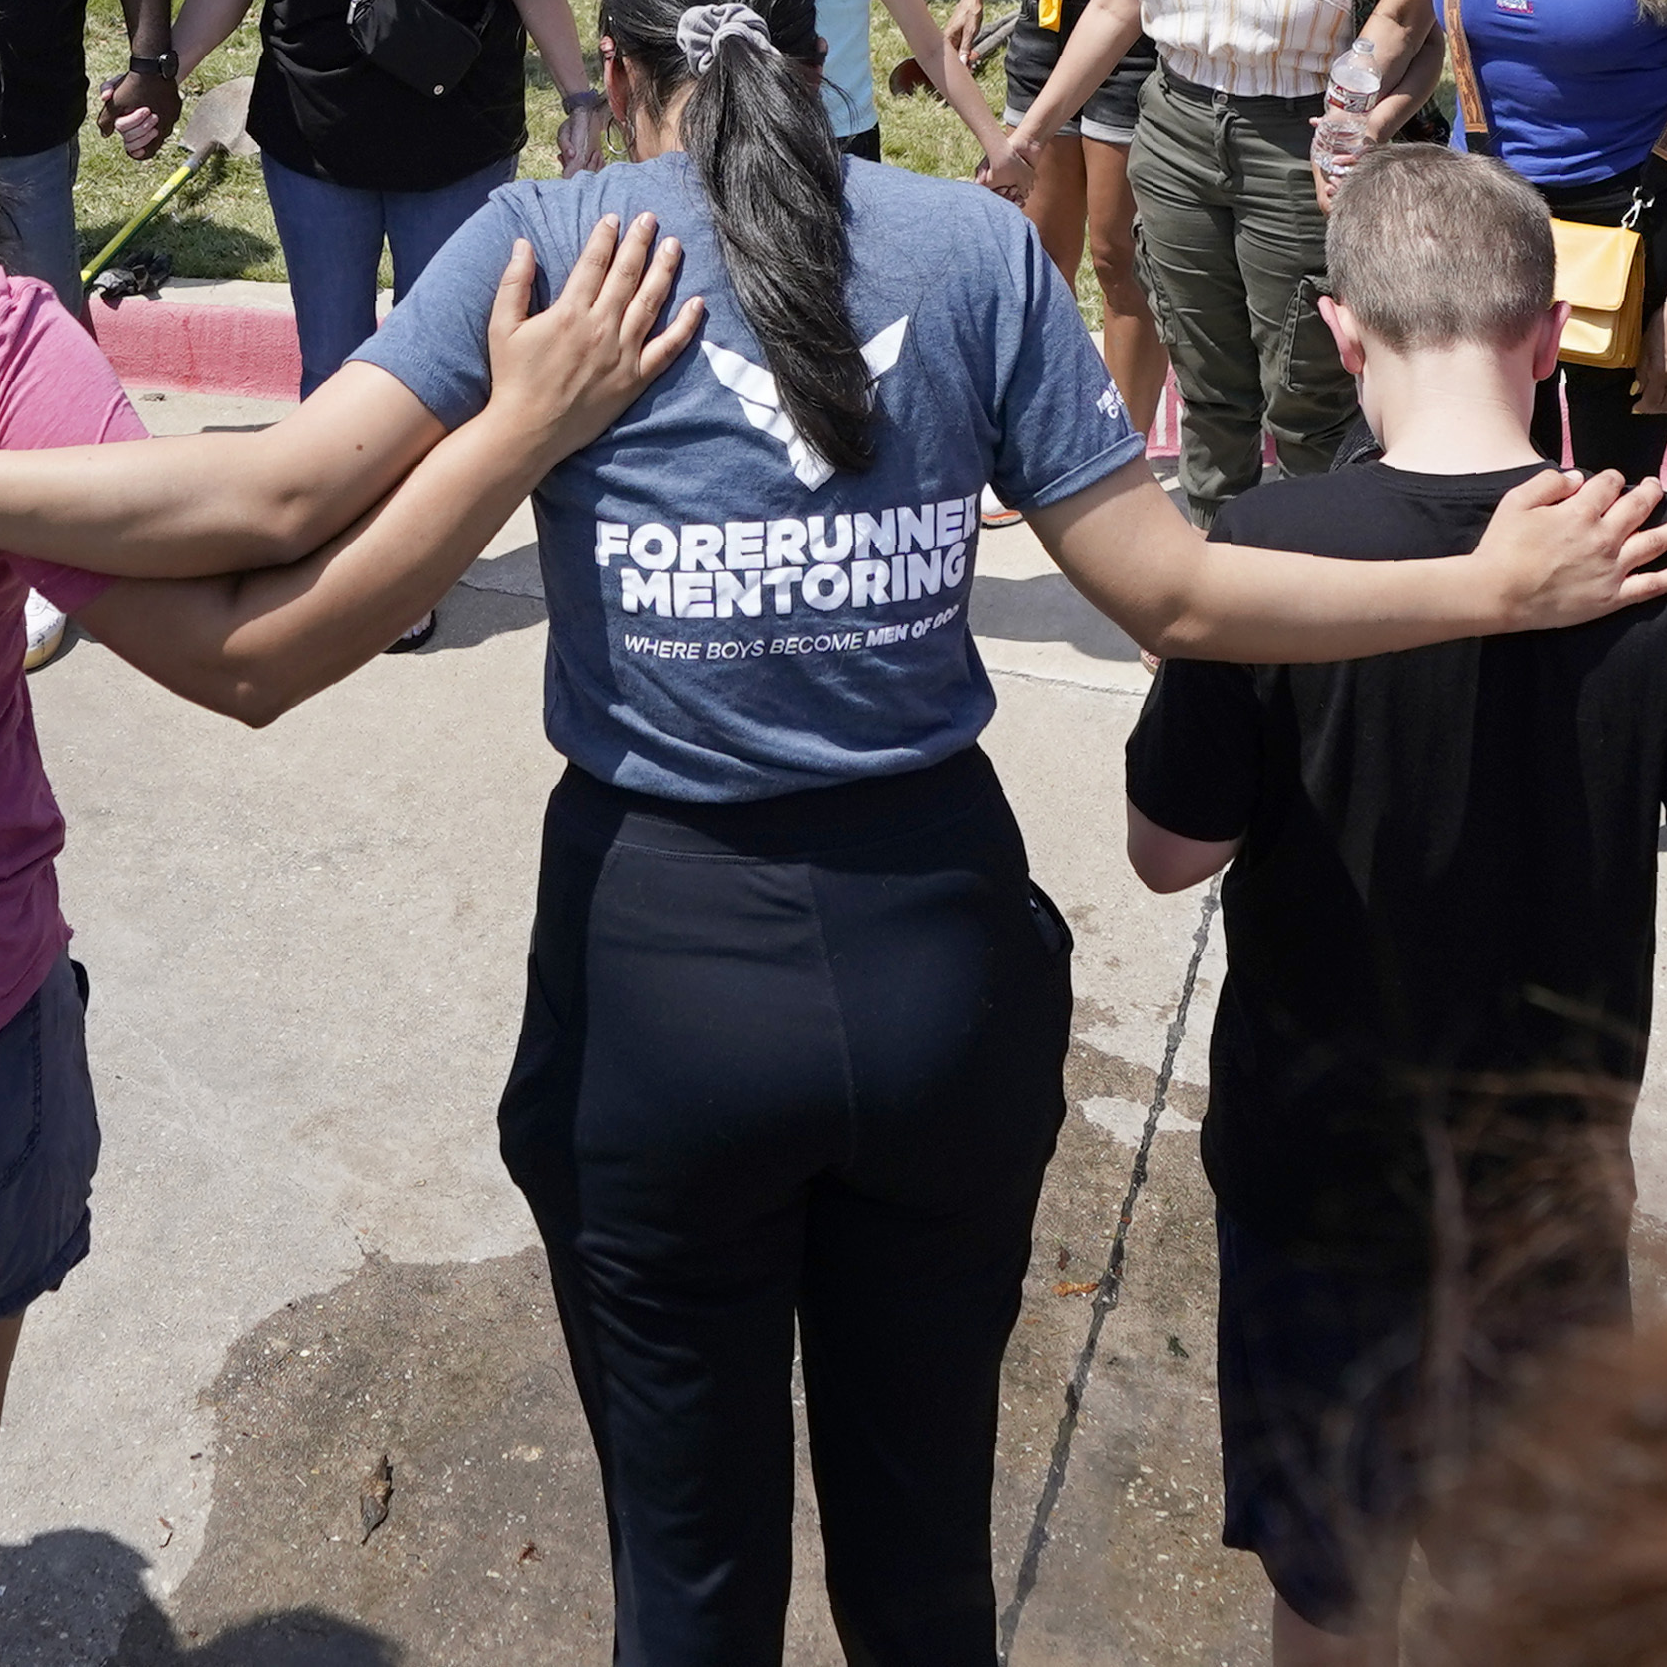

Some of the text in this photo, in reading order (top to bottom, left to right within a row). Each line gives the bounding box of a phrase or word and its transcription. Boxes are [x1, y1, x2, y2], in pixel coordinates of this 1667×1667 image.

[595, 493, 977, 572] FORERUNNER
[621, 543, 966, 619] MENTORING
[624, 634, 702, 660] WHERE
[706, 640, 765, 660] BOYS
[770, 631, 864, 655] BECOME
[866, 624, 907, 648] MEN
[912, 617, 933, 639] OF
